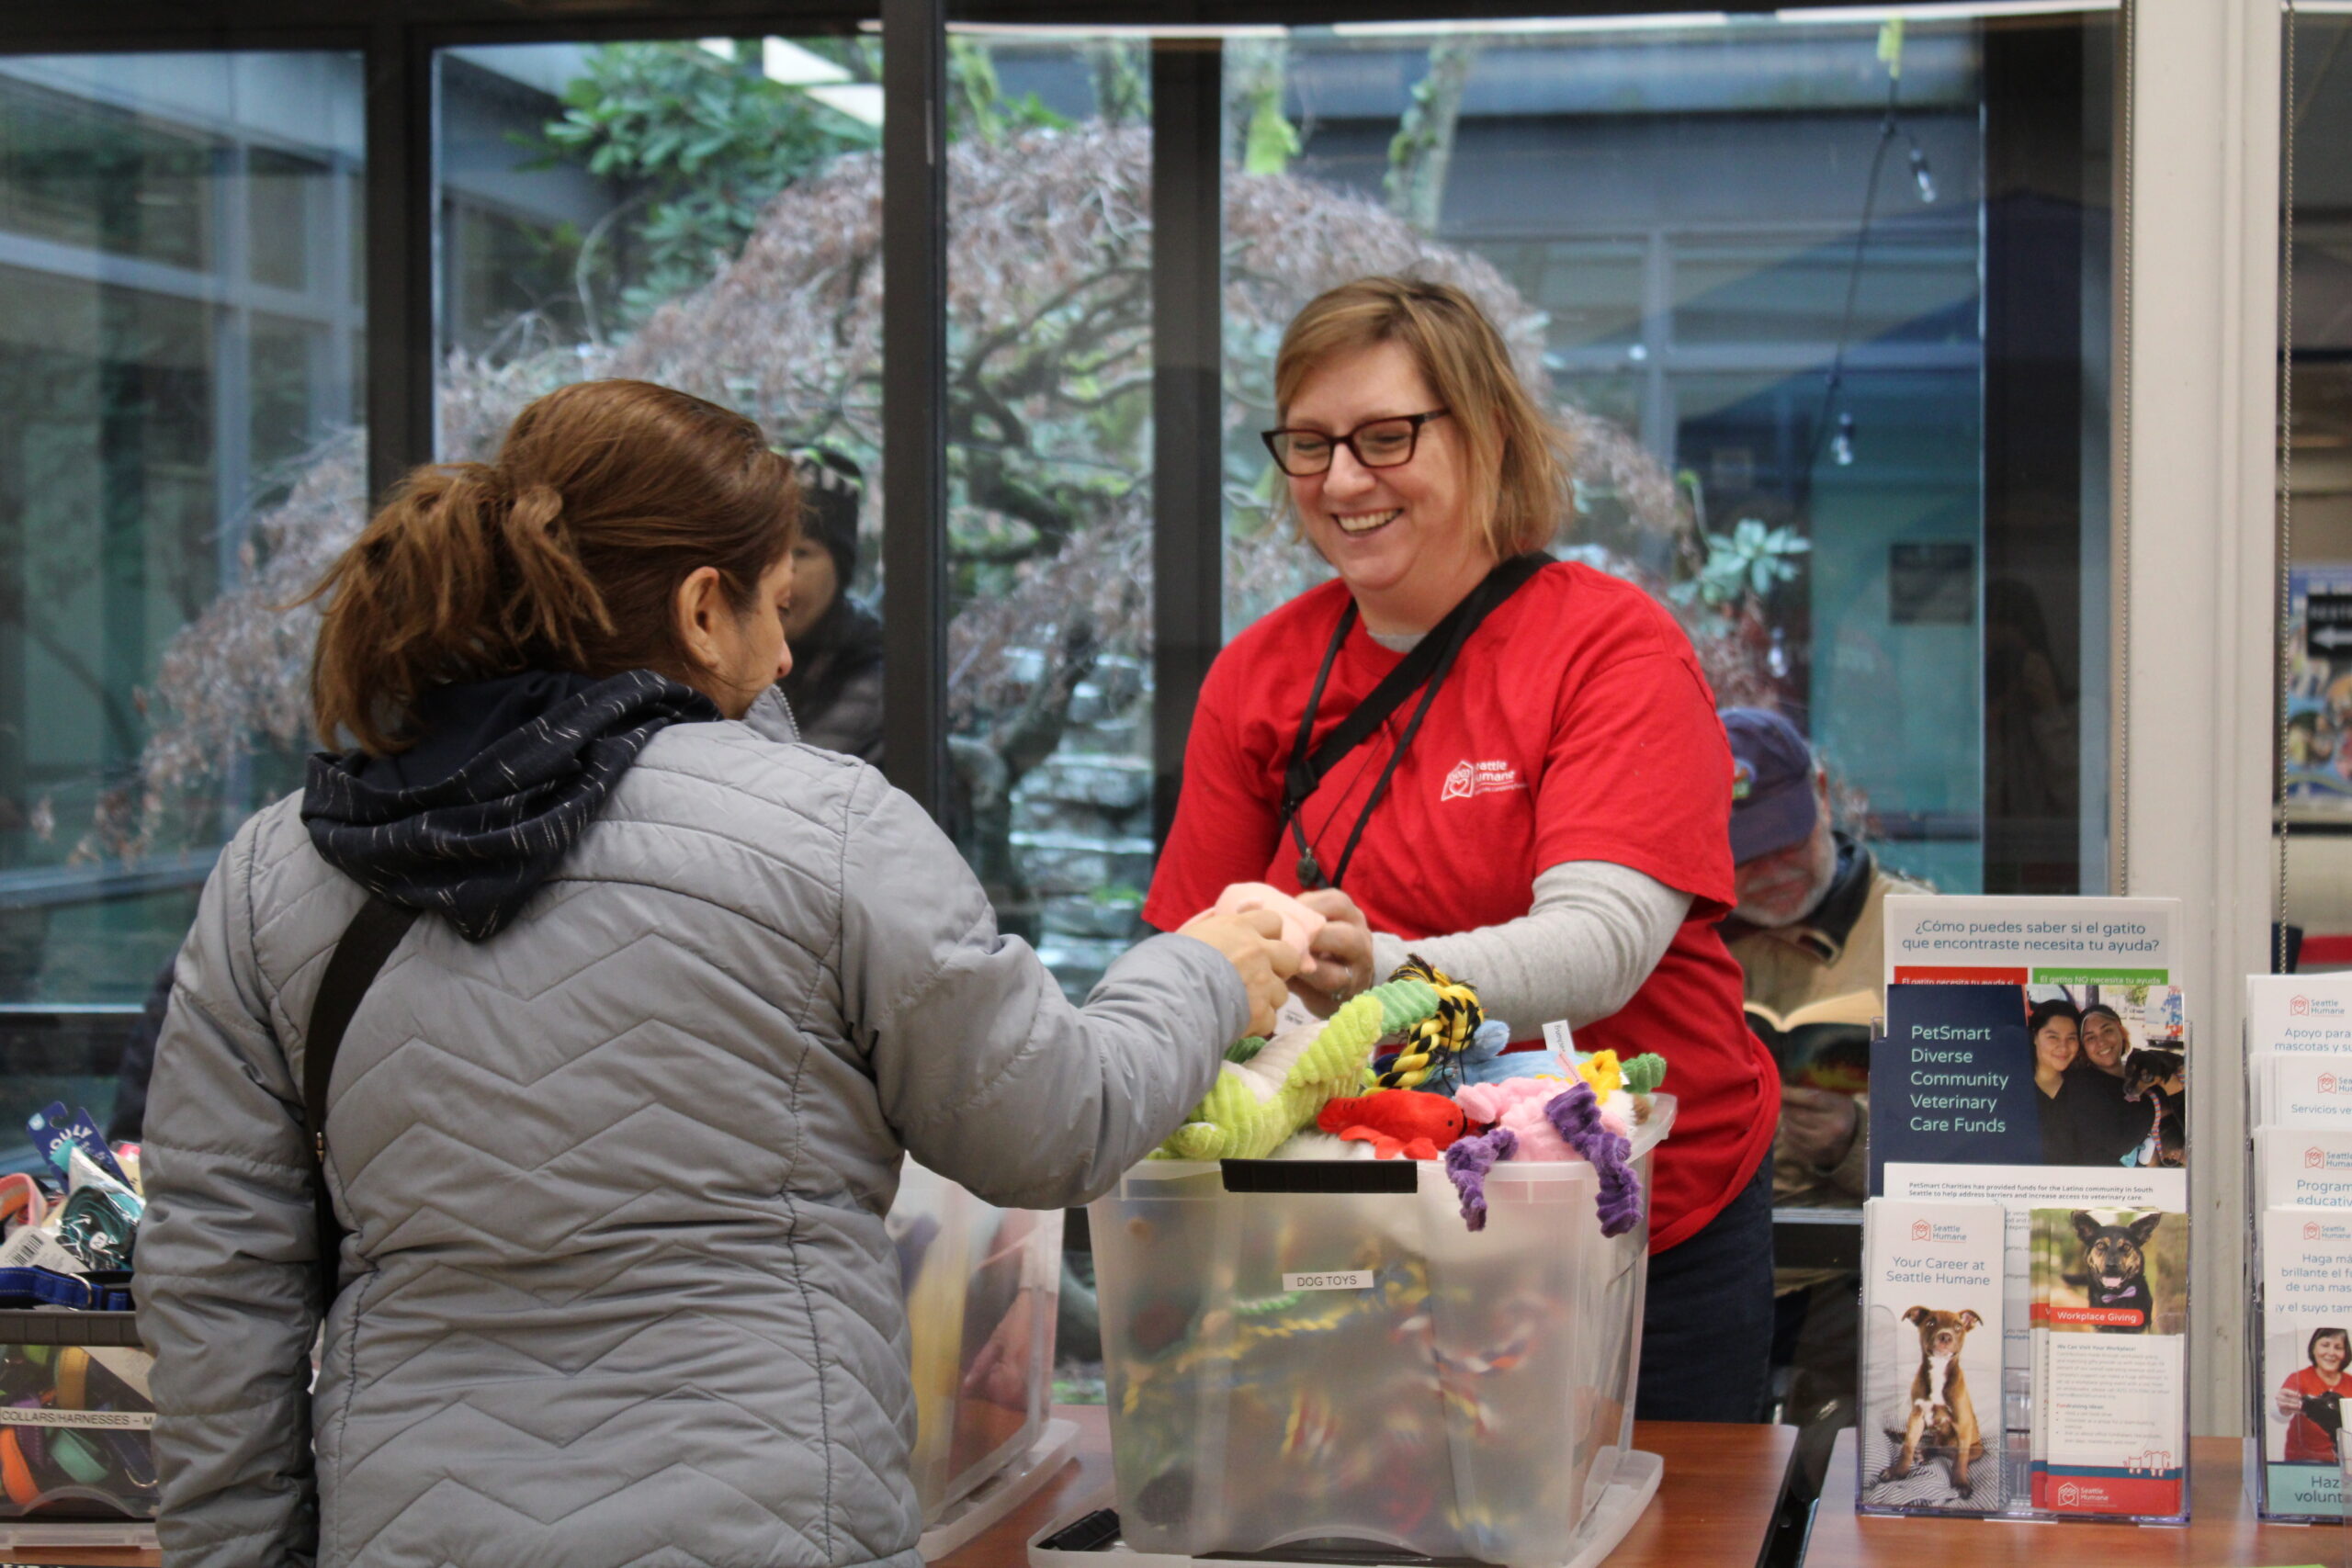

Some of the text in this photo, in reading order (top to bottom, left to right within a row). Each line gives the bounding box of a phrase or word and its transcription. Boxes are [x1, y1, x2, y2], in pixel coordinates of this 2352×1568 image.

[1915, 919, 2146, 938] ¿Cómo puedes saber si el gatito
[1902, 939, 2160, 954] que encontraste necesita tu ayuda?
[2050, 976, 2073, 985] gatito
[2075, 976, 2088, 984] NO
[2136, 976, 2161, 985] ayuda
[1911, 1025, 1991, 1041] PetSmart
[2284, 1028, 2351, 1040] Apoyo para
[2274, 1042, 2329, 1052] mascotas
[2333, 1044, 2339, 1054] y
[1911, 1048, 1973, 1063] Diverse
[1910, 1071, 2009, 1090] Community
[1910, 1094, 1997, 1112] Veterinary
[2291, 1104, 2337, 1115] Servicios
[1910, 1117, 2006, 1133] Care Funds
[50, 1123, 94, 1155] OULY
[2085, 1186, 2124, 1194] community
[1933, 1224, 1961, 1232] Seattle
[1933, 1232, 1967, 1241] Humane
[1893, 1256, 1985, 1270] Your Career at
[2302, 1254, 2333, 1266] Haga
[1886, 1270, 1931, 1283] Seattle
[1936, 1272, 1991, 1286] Humane
[2281, 1268, 2328, 1279] brillante
[2332, 1269, 2341, 1278] el
[1296, 1275, 1358, 1287] DOG TOYS
[2286, 1282, 2300, 1292] de
[2303, 1284, 2325, 1292] una
[2288, 1303, 2298, 1313] el
[2301, 1305, 2328, 1314] suyo
[2057, 1311, 2105, 1322] Workplace
[2108, 1313, 2138, 1324] Giving
[2311, 1475, 2340, 1489] Haz
